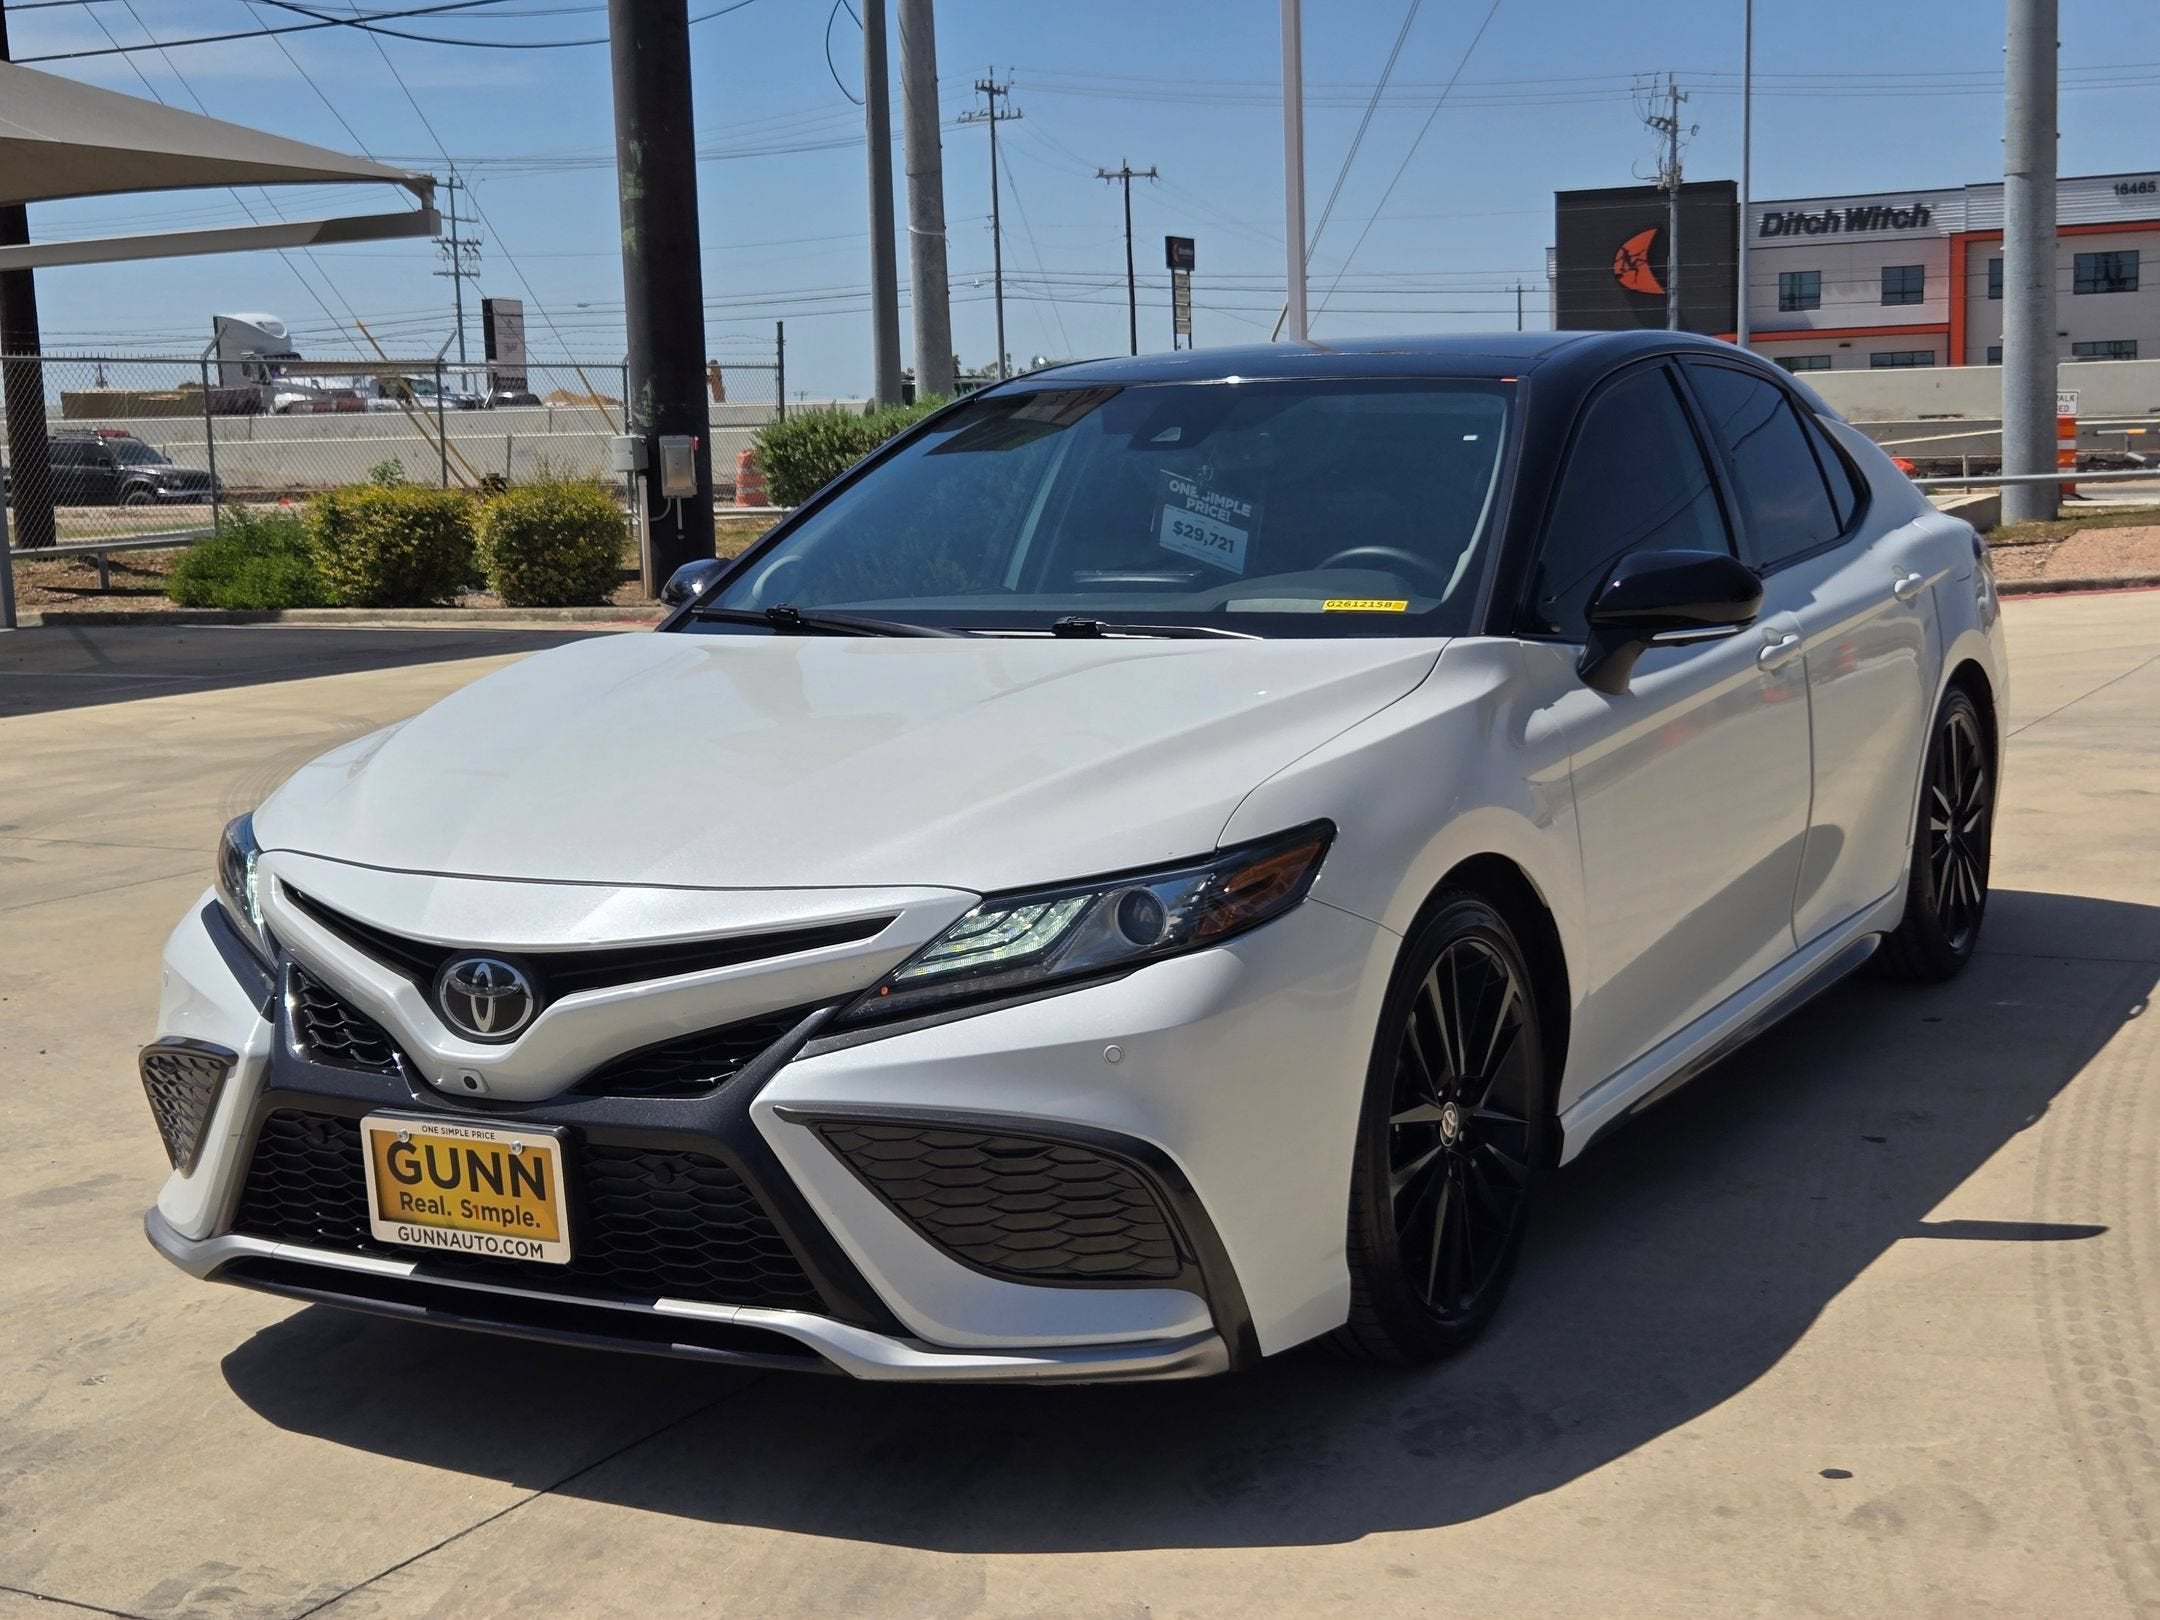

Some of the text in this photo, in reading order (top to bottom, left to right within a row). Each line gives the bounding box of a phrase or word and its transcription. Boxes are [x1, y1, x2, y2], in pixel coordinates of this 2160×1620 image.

[1759, 203, 1931, 238] Ditch Witch
[1169, 480, 1200, 498] ONE
[1186, 497, 1231, 522] PRICE!
[1172, 520, 1235, 553] $29,721
[421, 1125, 496, 1140] ONE SIMPLE PRICE
[387, 1140, 546, 1201] GUNN
[400, 1191, 452, 1217] Real.
[398, 1225, 544, 1259] GUNNAUTO.COM
